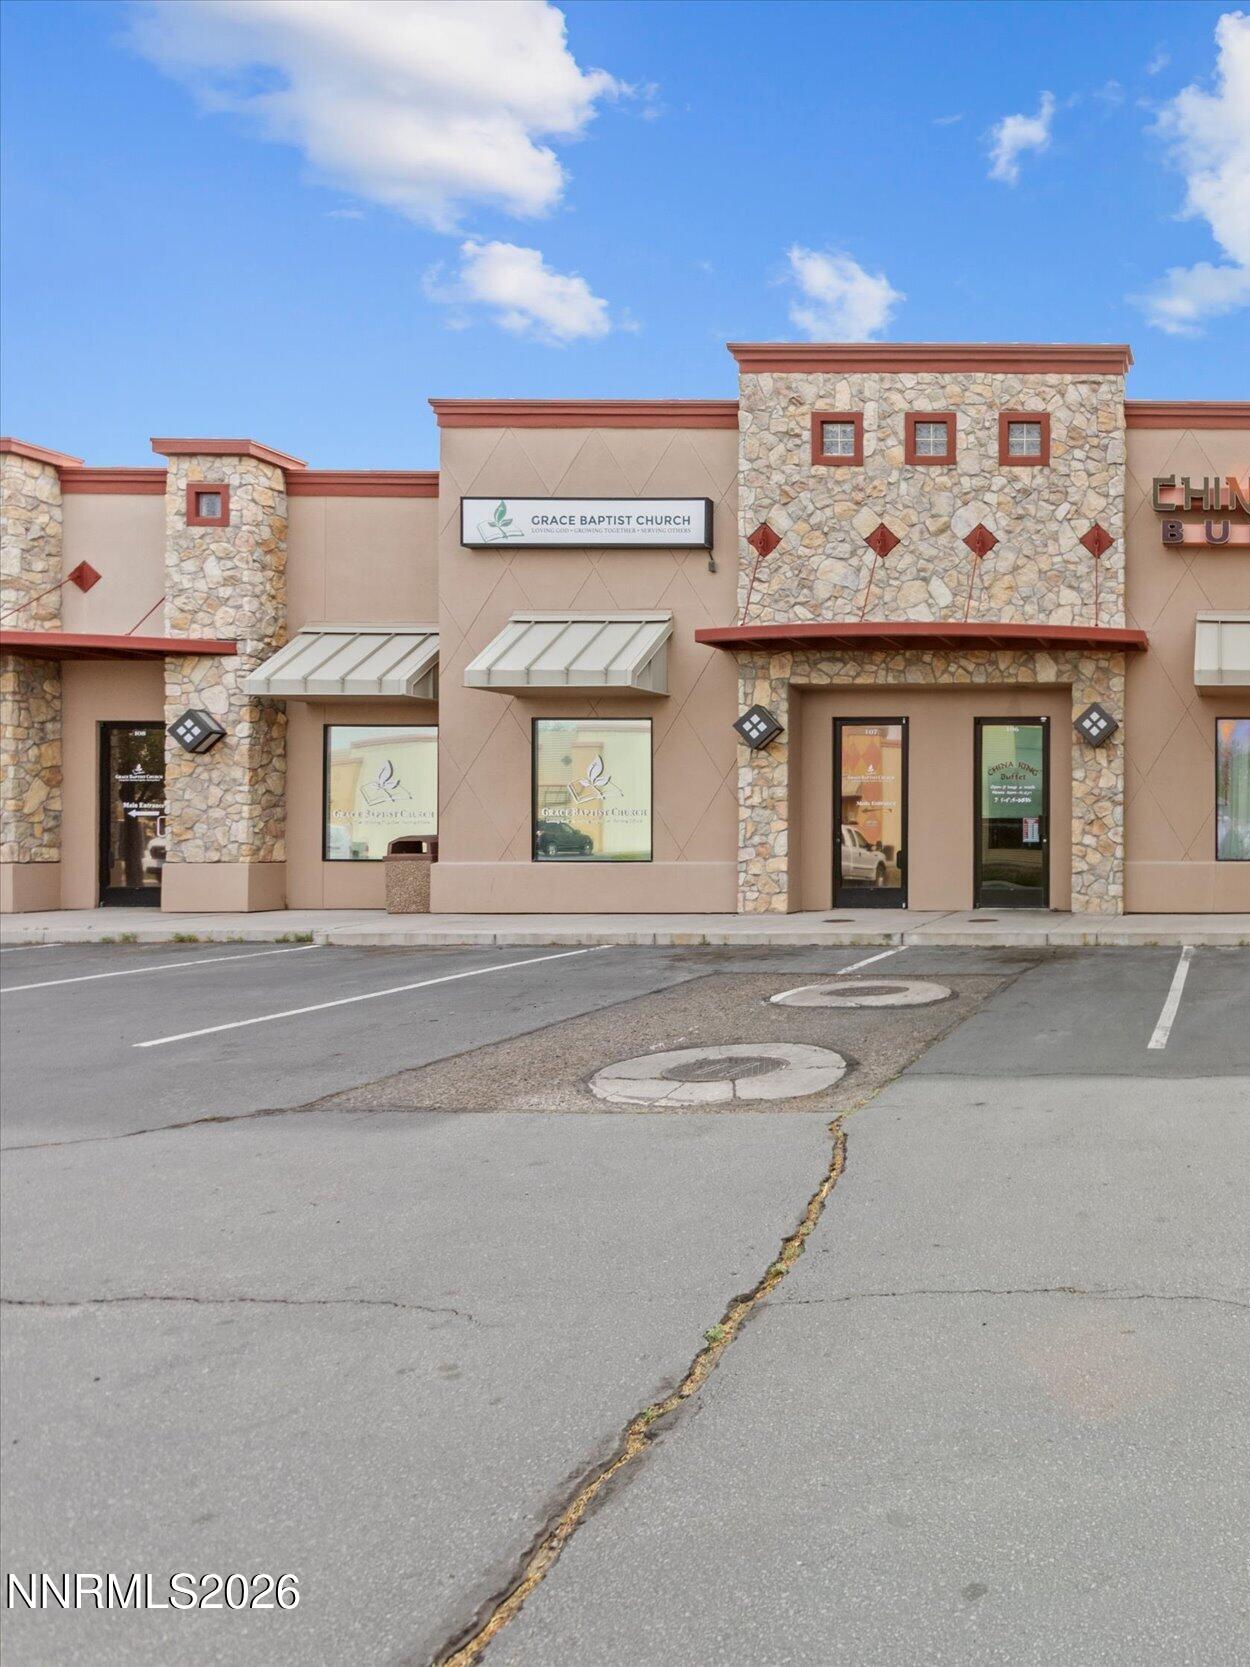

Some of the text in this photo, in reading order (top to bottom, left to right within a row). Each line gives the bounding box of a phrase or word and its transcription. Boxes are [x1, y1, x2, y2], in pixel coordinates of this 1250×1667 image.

[531, 515, 691, 526] GRACE BAPTIST CHURCH
